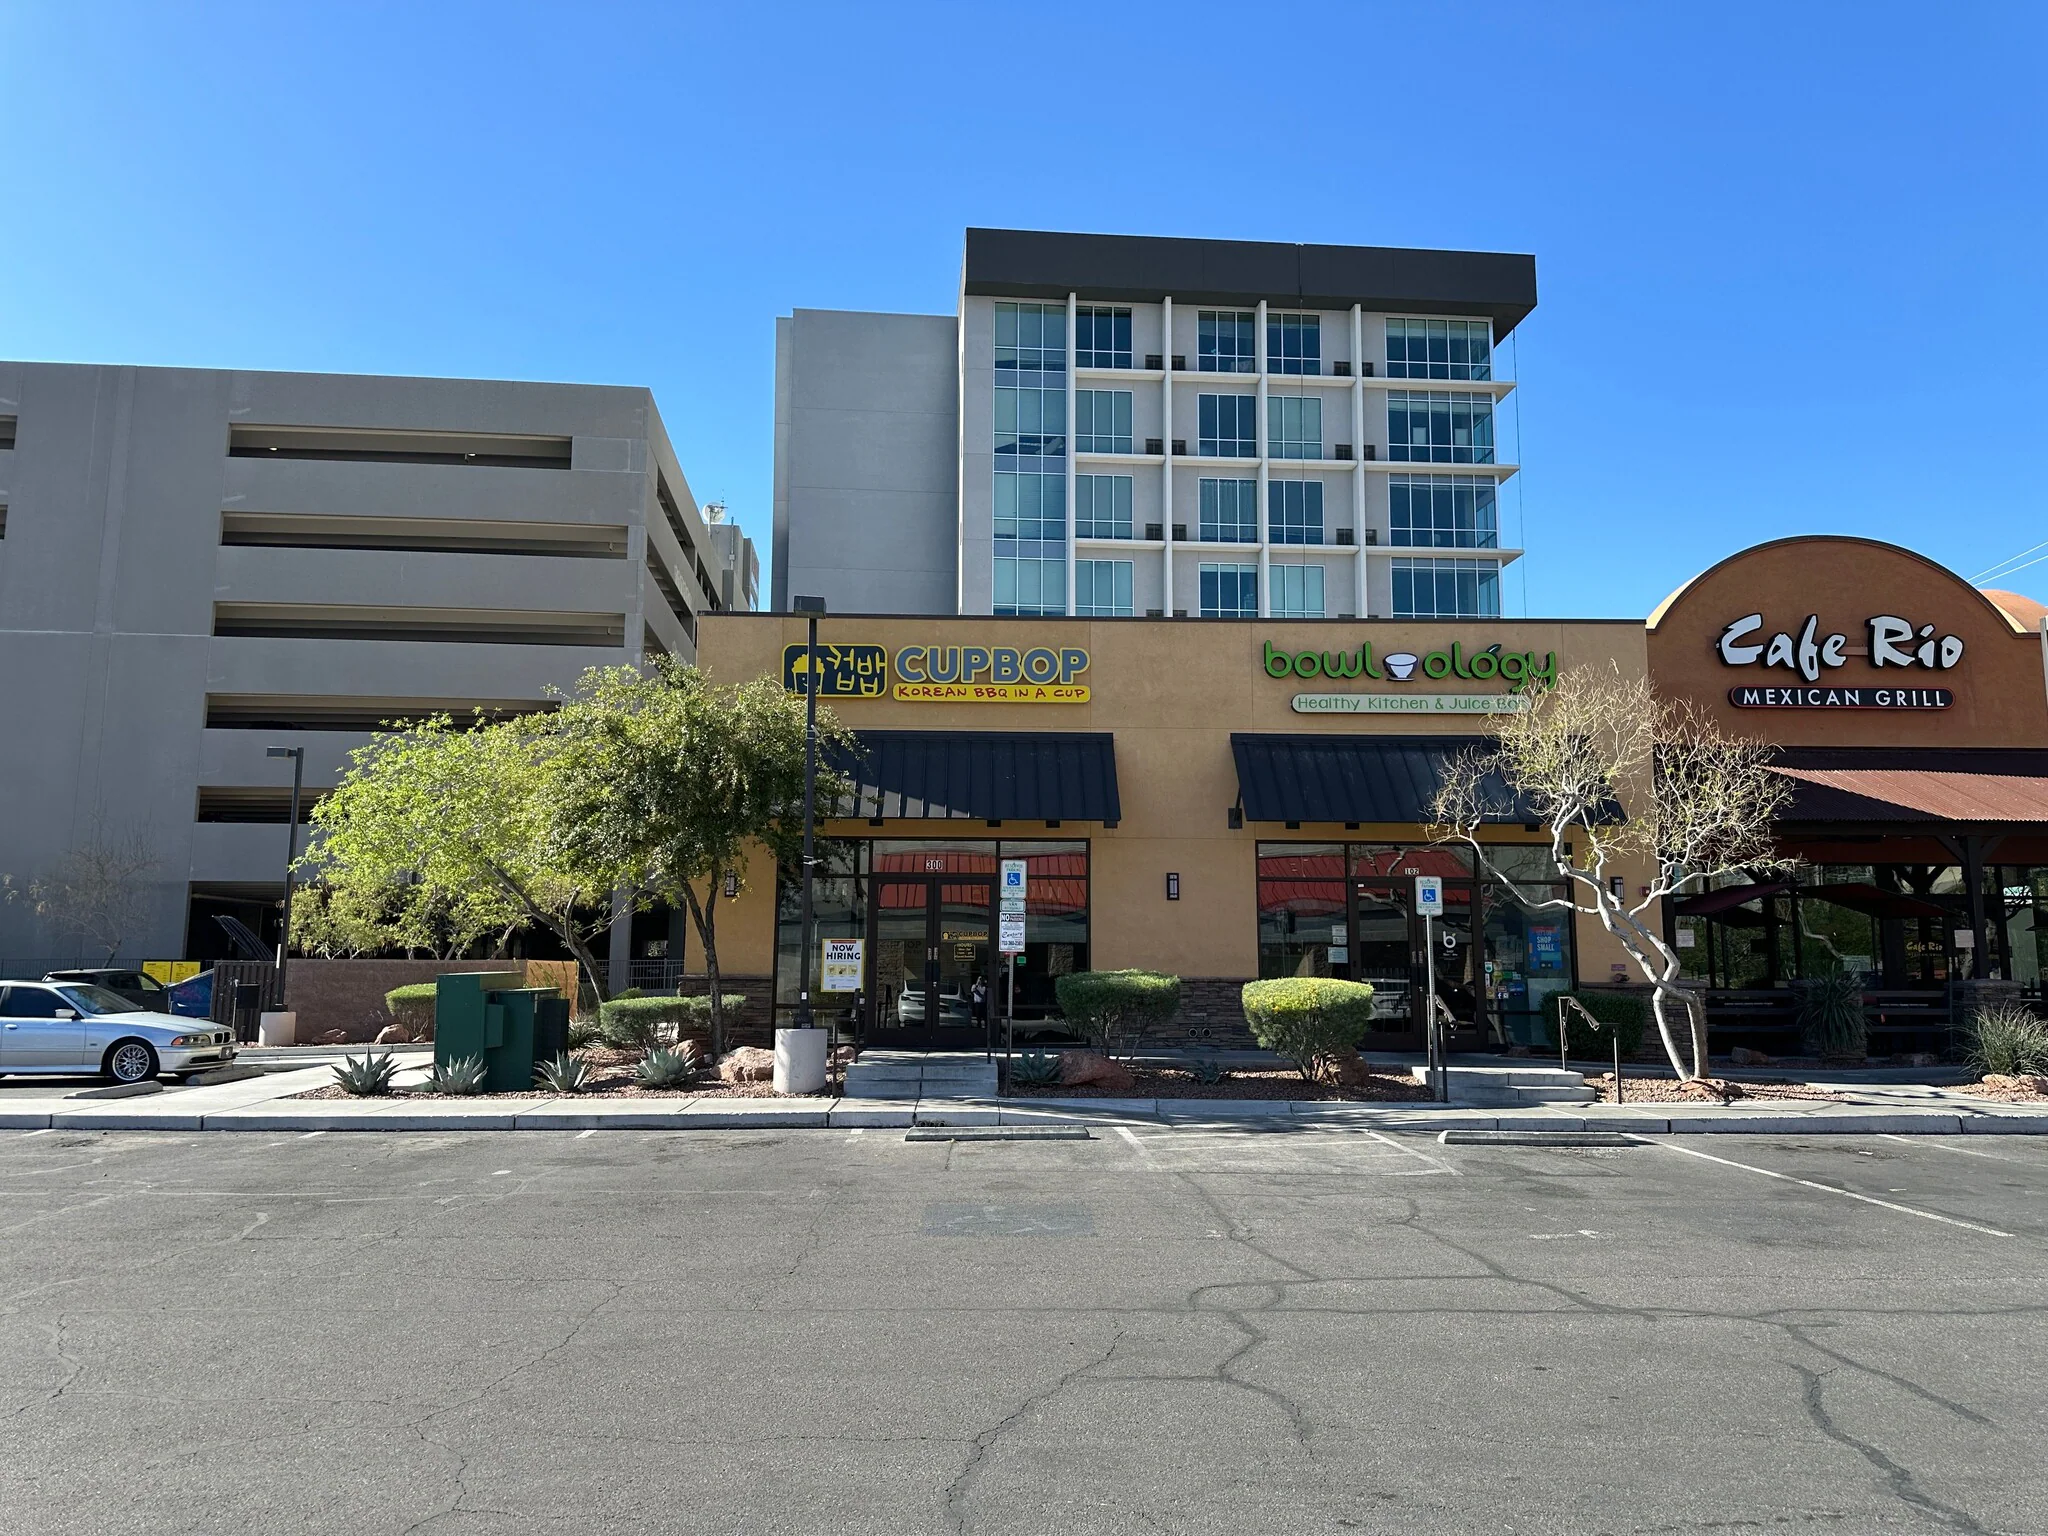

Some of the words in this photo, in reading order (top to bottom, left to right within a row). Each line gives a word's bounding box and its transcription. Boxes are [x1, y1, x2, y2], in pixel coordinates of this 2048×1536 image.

[1717, 613, 1847, 683] Cafe
[894, 645, 1091, 685] CUPBOP
[1264, 640, 1383, 678] bowl
[898, 686, 967, 698] KOREAN
[973, 688, 1008, 698] BBQ
[1014, 689, 1029, 698] IN
[1035, 688, 1046, 698] A
[1053, 689, 1086, 698] CUP
[1743, 689, 1860, 706] MEXICAN
[1875, 690, 1945, 707] GRILL
[1298, 697, 1360, 711] Healthy
[1368, 697, 1429, 709] Kitchen
[1434, 697, 1444, 710] &
[1449, 698, 1490, 709] Juice
[1497, 698, 1524, 709] Ba
[926, 860, 942, 869] 300
[832, 944, 854, 952] NOW
[1536, 943, 1555, 951] SMALL
[826, 952, 861, 960] HIRING
